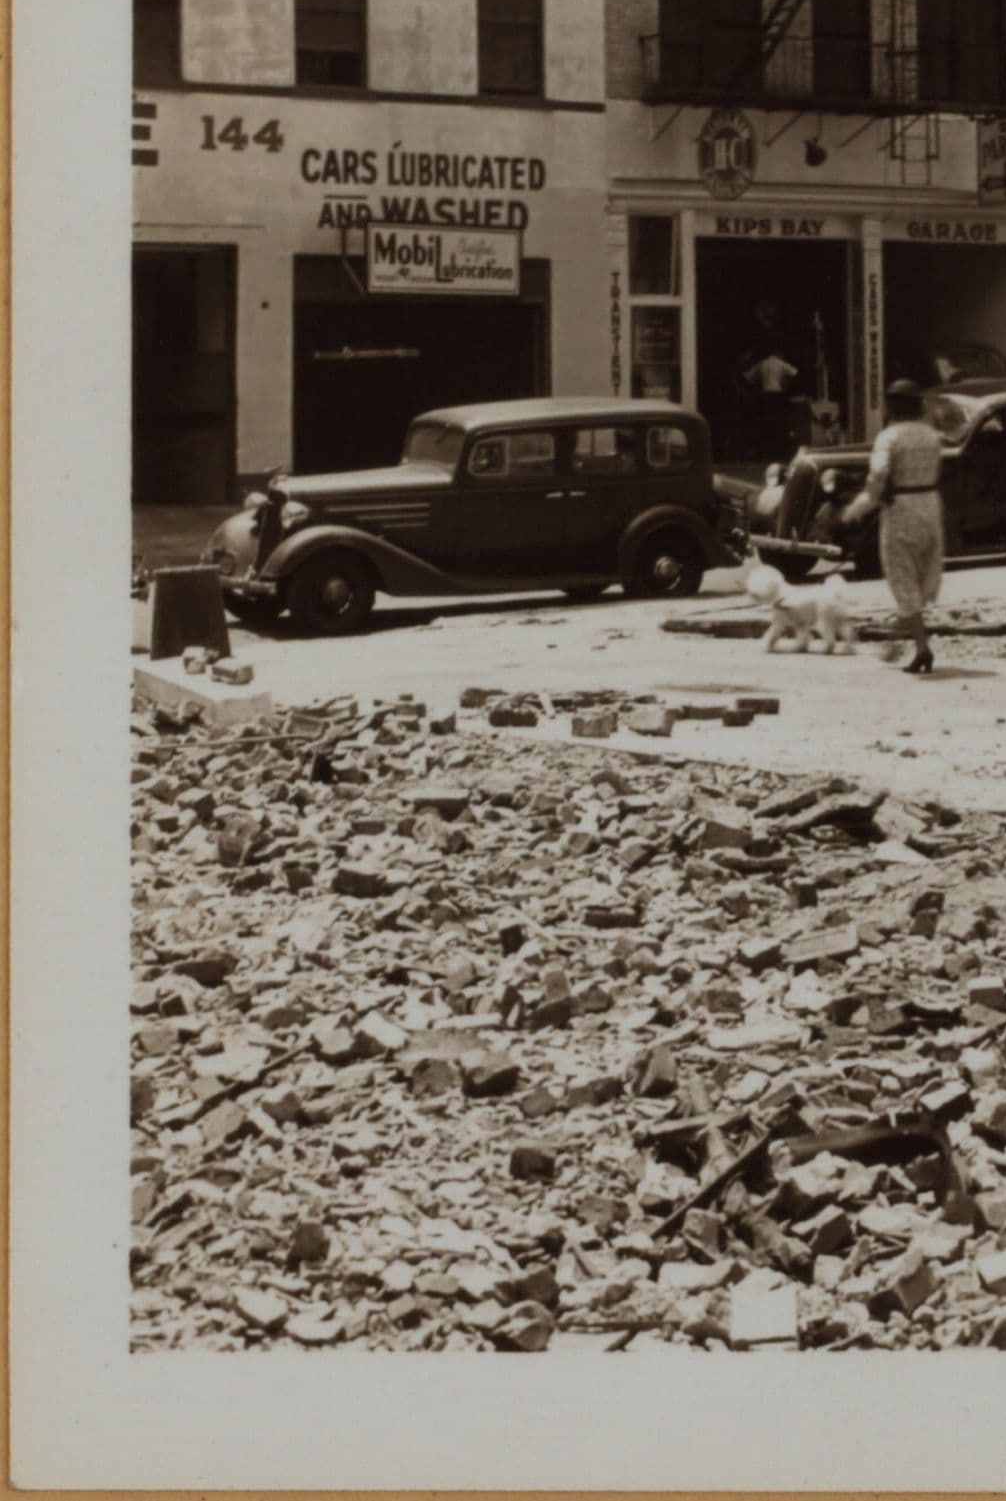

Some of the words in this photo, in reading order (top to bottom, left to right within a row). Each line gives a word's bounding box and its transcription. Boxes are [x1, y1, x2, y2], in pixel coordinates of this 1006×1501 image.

[200, 115, 284, 153] 144
[301, 148, 378, 185] CARS
[387, 150, 547, 192] LUBRICATED
[318, 201, 373, 229] AND
[381, 195, 530, 231] WASHED
[715, 217, 773, 237] KIPS
[781, 218, 826, 238] BAY
[906, 221, 998, 242] GARAGE
